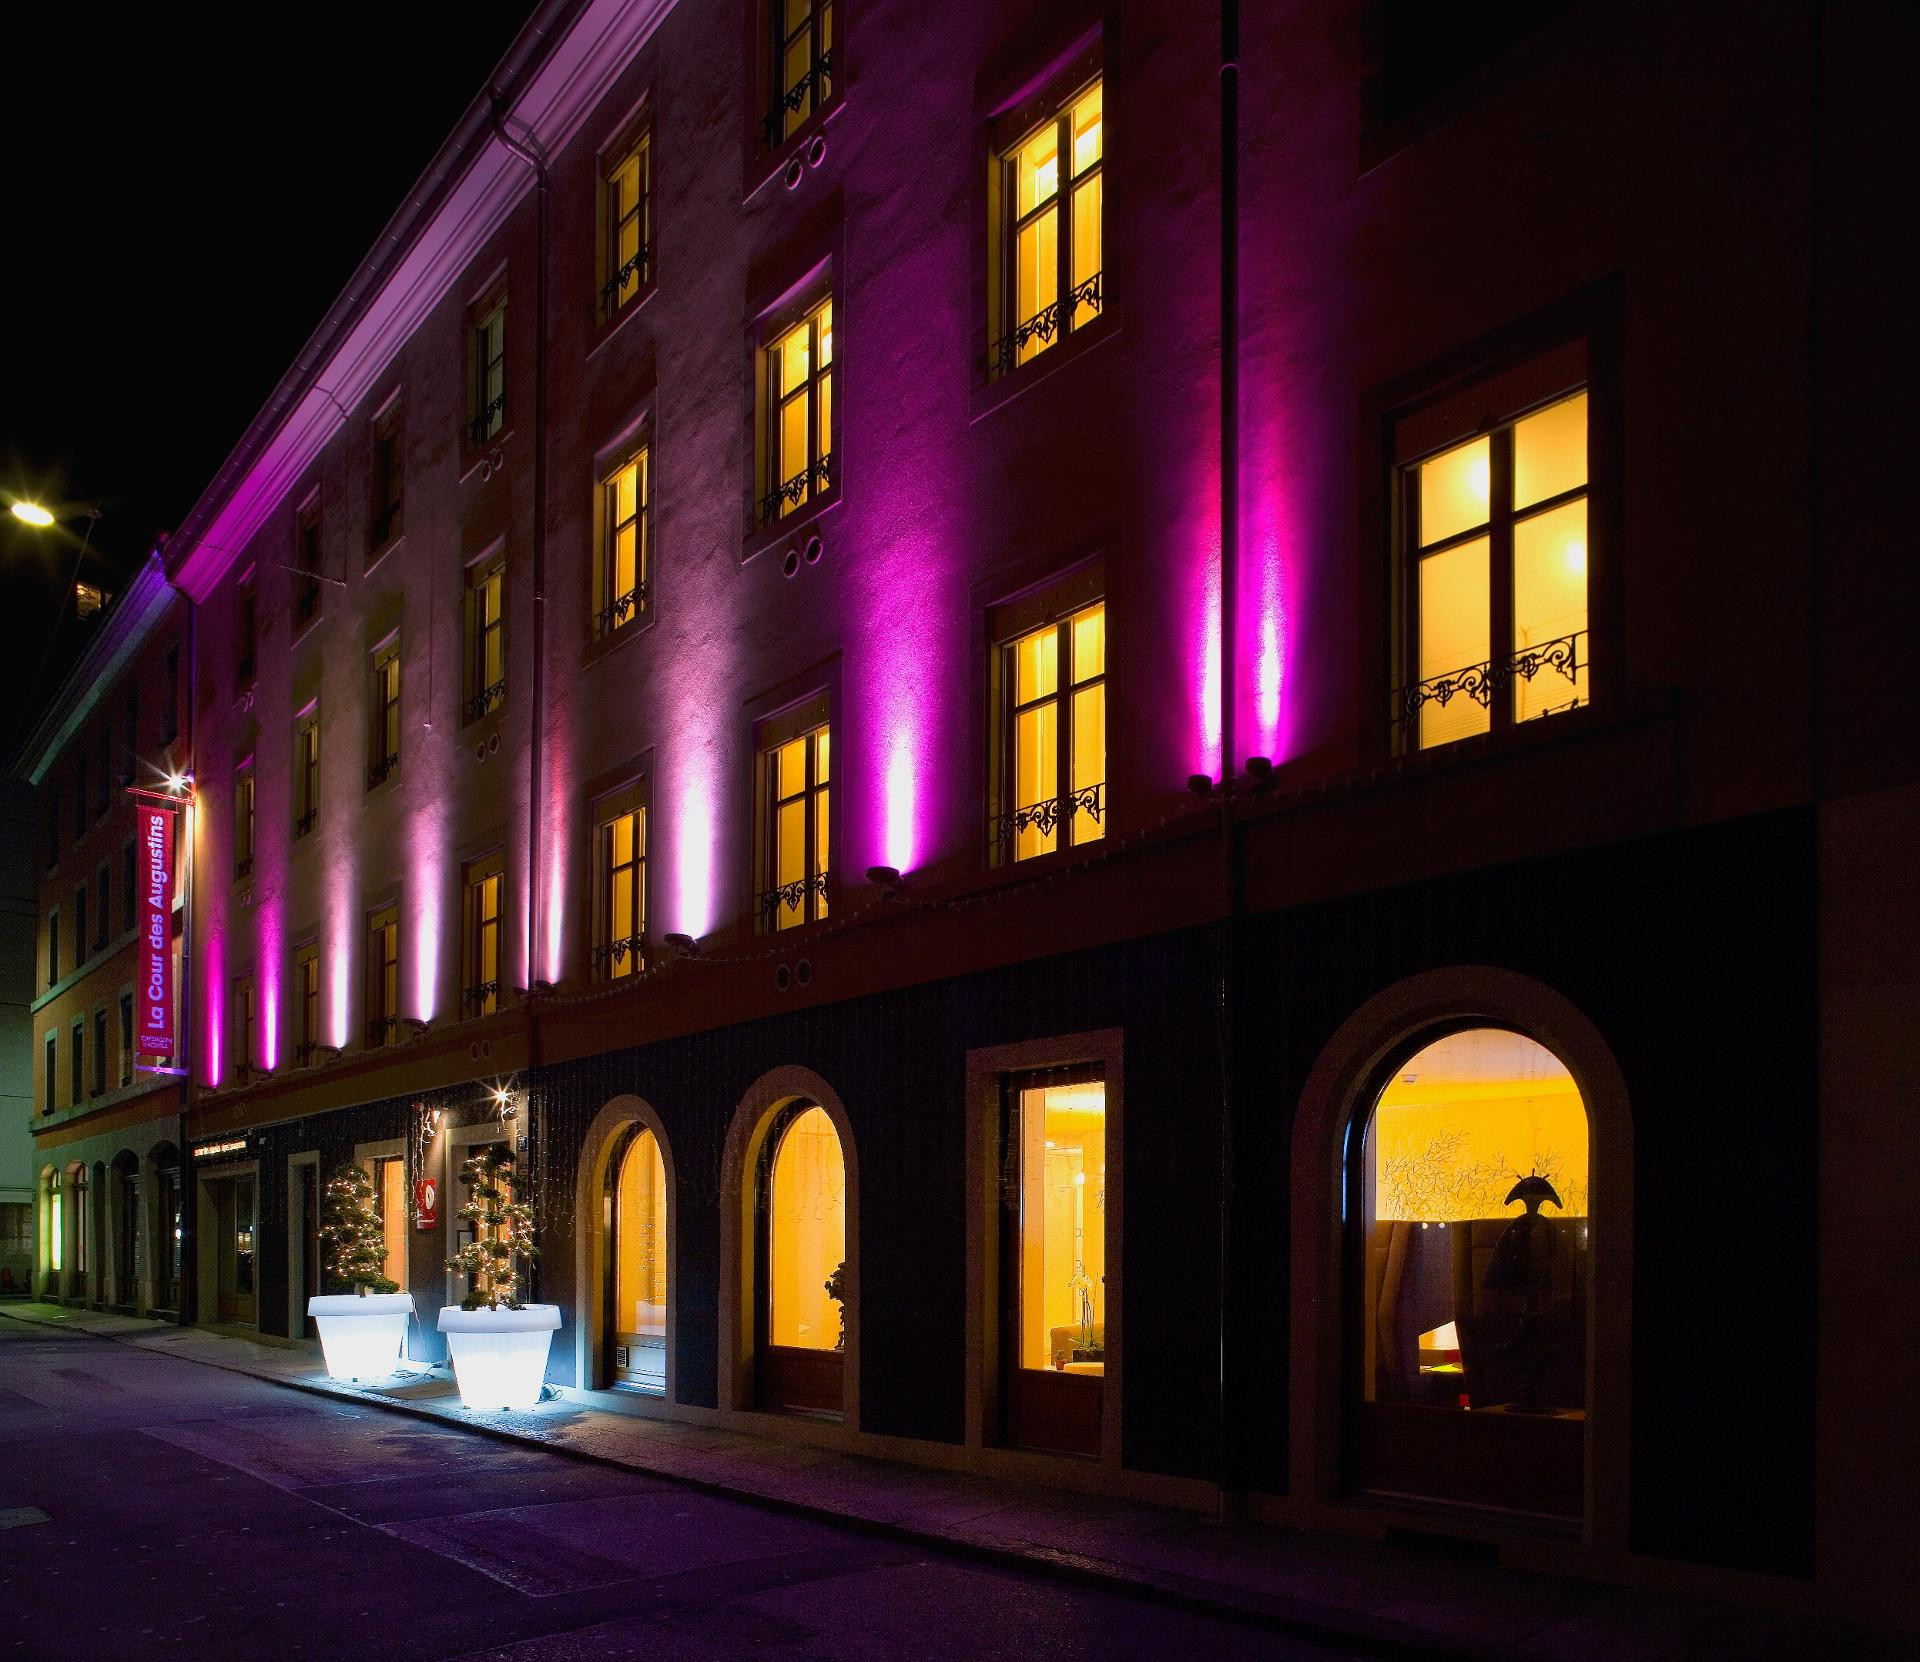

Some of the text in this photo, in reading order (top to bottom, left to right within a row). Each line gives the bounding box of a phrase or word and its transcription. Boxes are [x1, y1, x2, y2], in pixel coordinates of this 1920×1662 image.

[148, 815, 168, 1029] La Cour des Augustins
